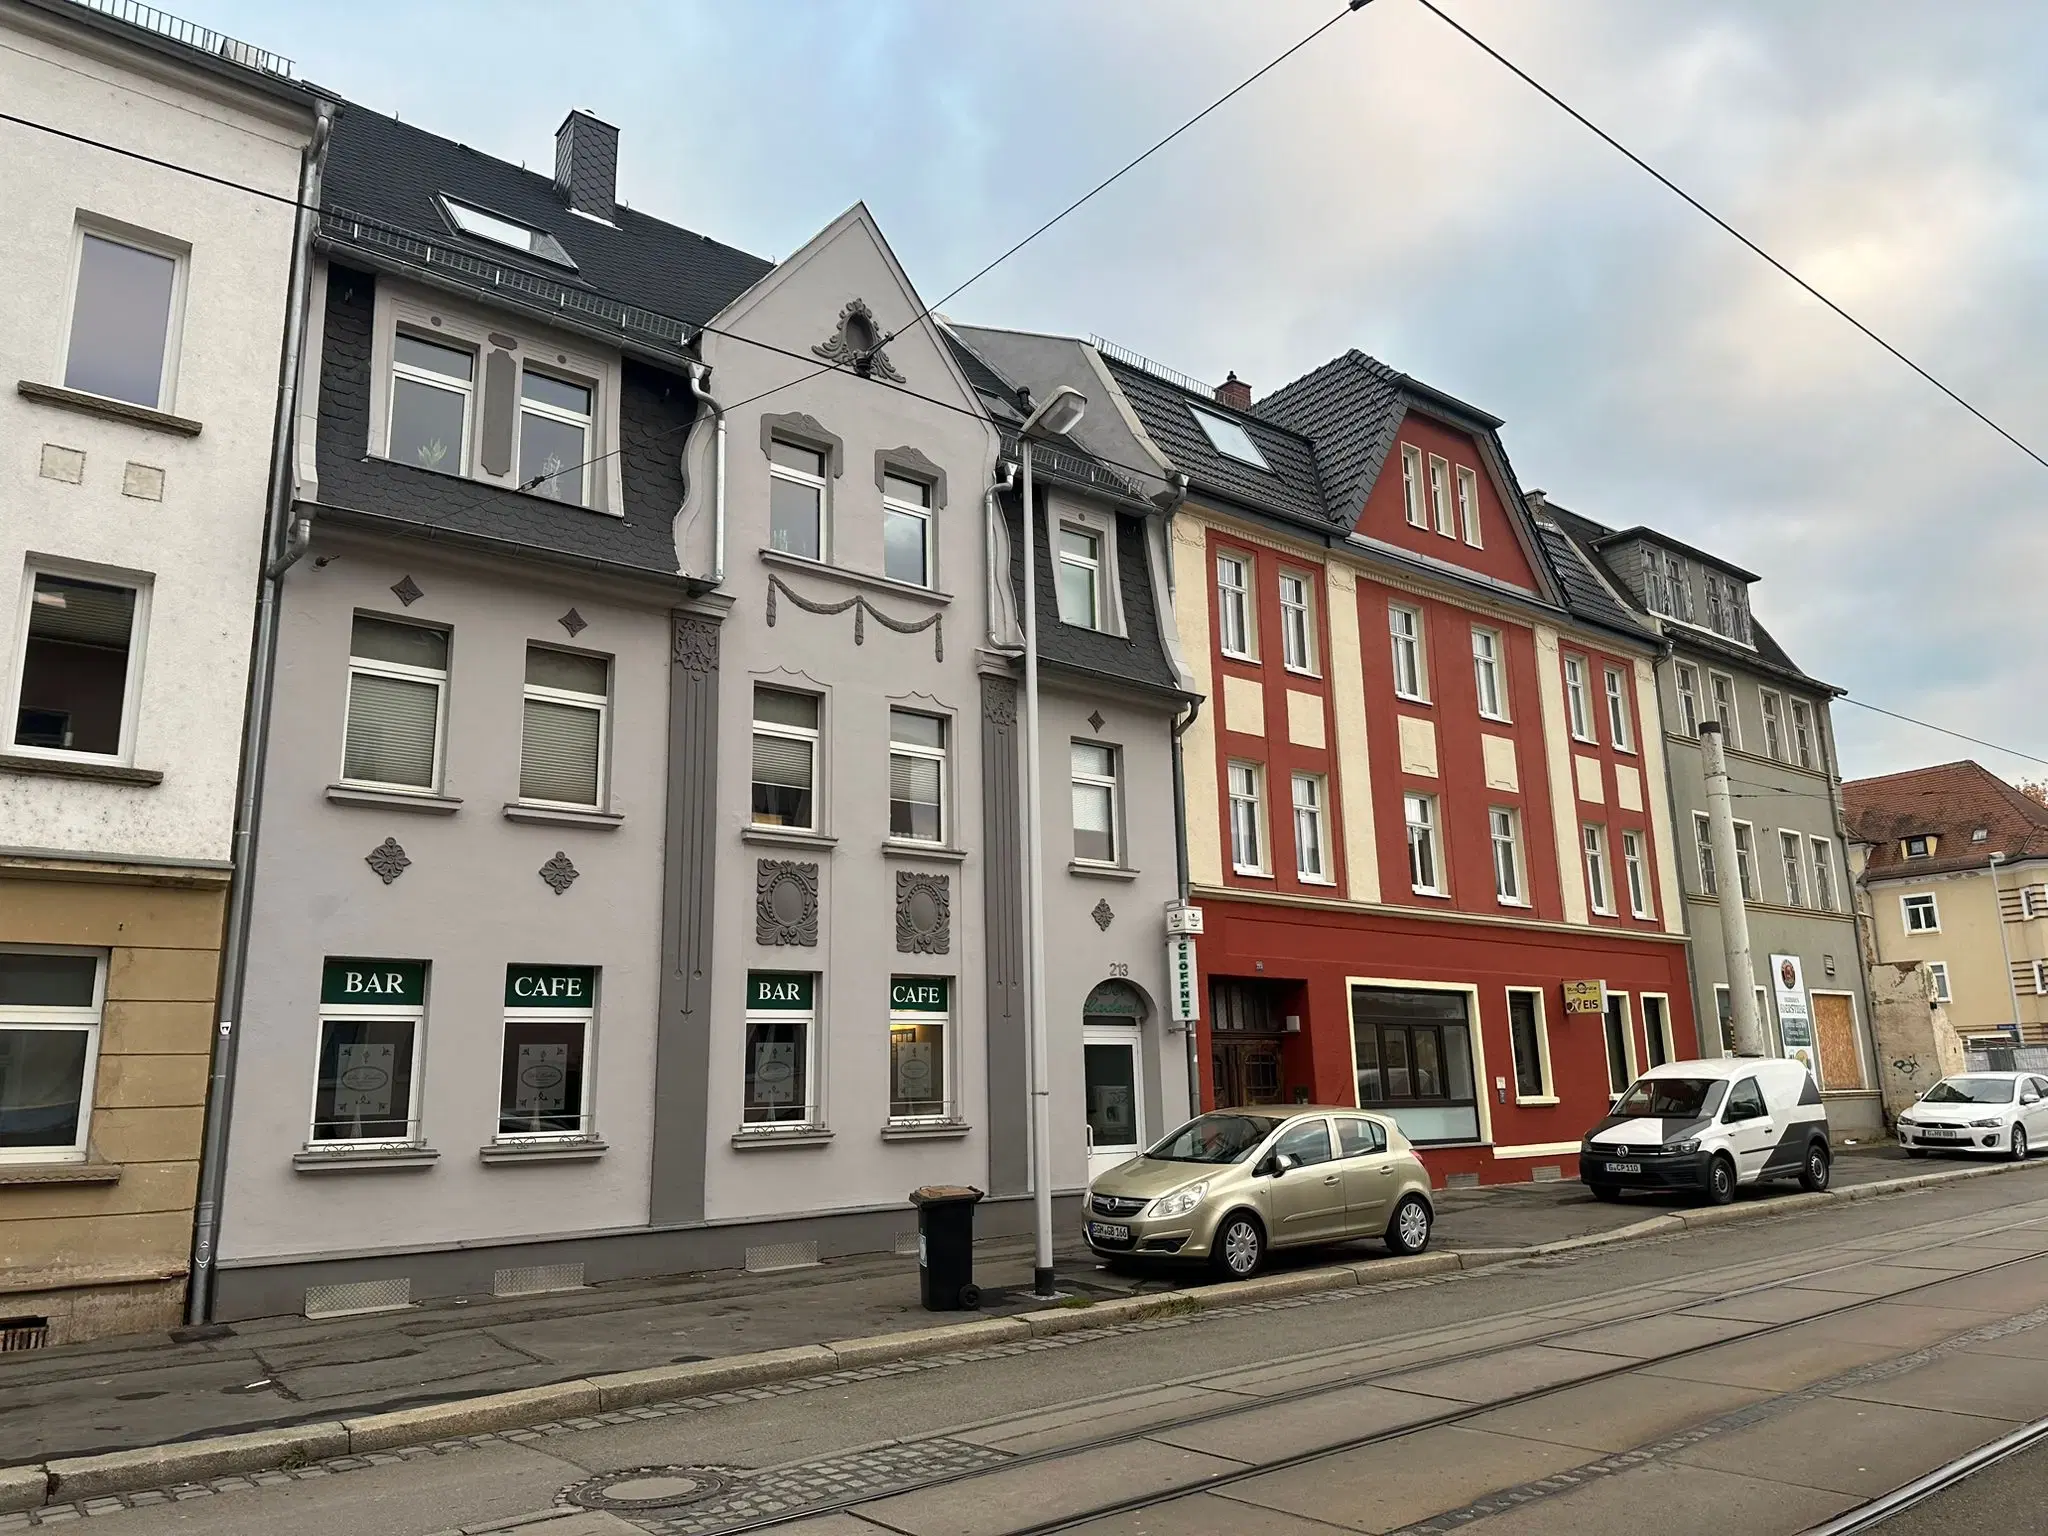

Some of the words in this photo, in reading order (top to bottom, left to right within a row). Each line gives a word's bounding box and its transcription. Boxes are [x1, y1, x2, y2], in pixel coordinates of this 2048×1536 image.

[1109, 963, 1129, 977] 213
[344, 972, 404, 994] BAR
[514, 976, 583, 997] CAFE
[758, 982, 800, 1001] BAR
[892, 985, 941, 1004] CAFE
[1583, 999, 1599, 1010] EIS
